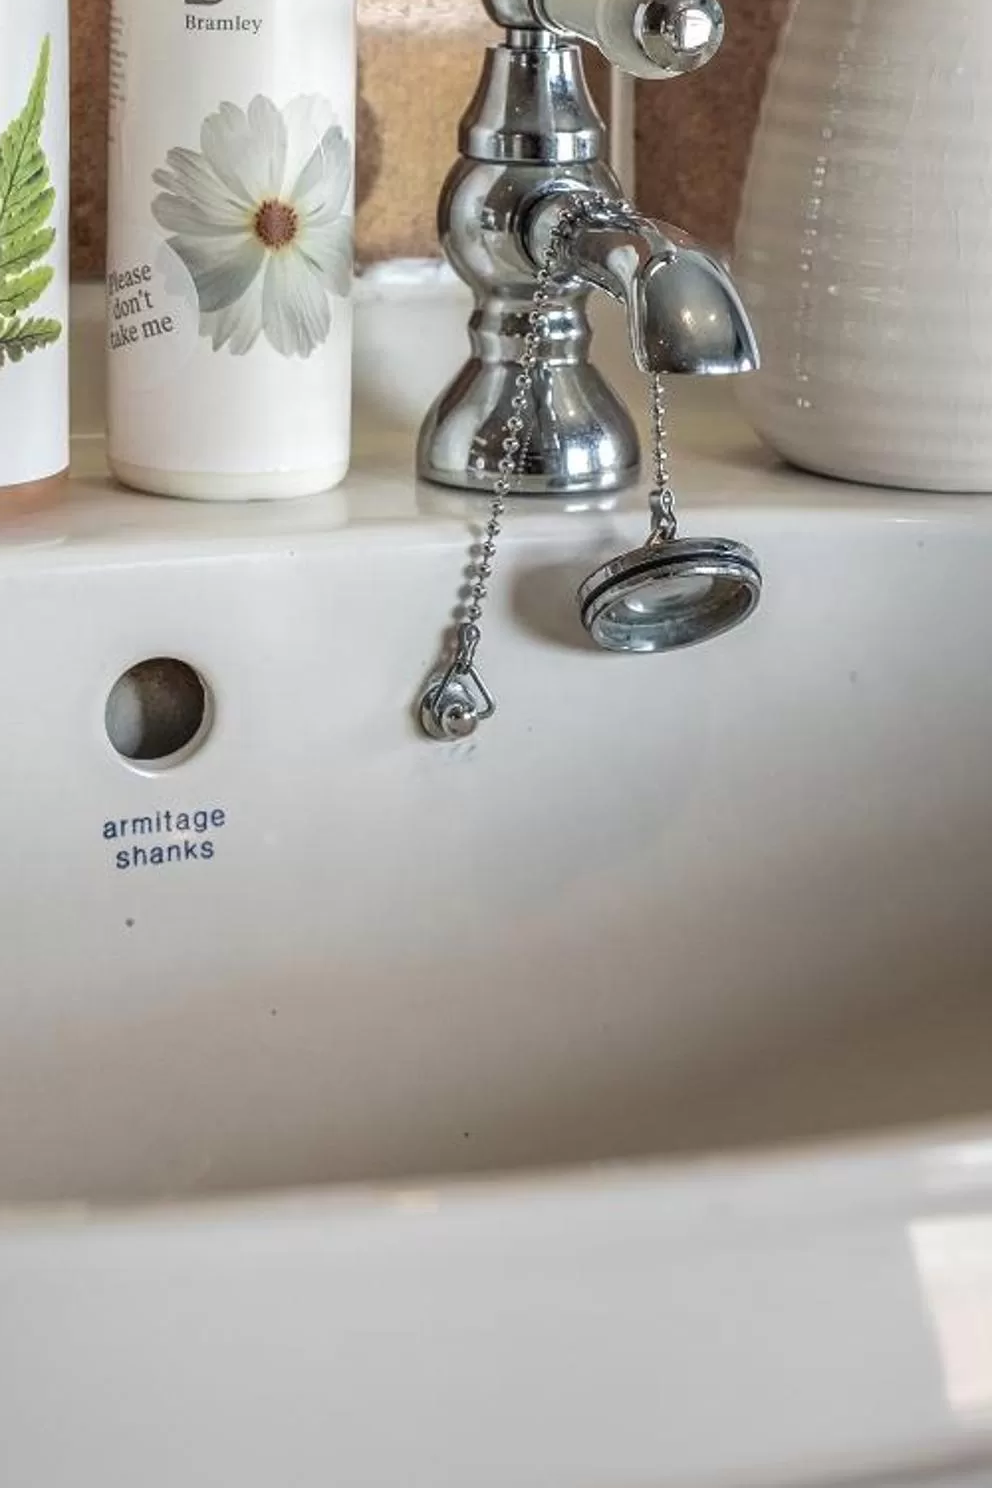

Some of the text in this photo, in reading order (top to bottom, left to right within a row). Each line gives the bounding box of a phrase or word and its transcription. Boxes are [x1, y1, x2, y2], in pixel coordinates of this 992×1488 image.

[184, 15, 263, 35] Bramley
[113, 289, 154, 320] don't
[141, 315, 174, 338] me
[102, 808, 226, 840] armitage
[115, 839, 215, 870] shanks
